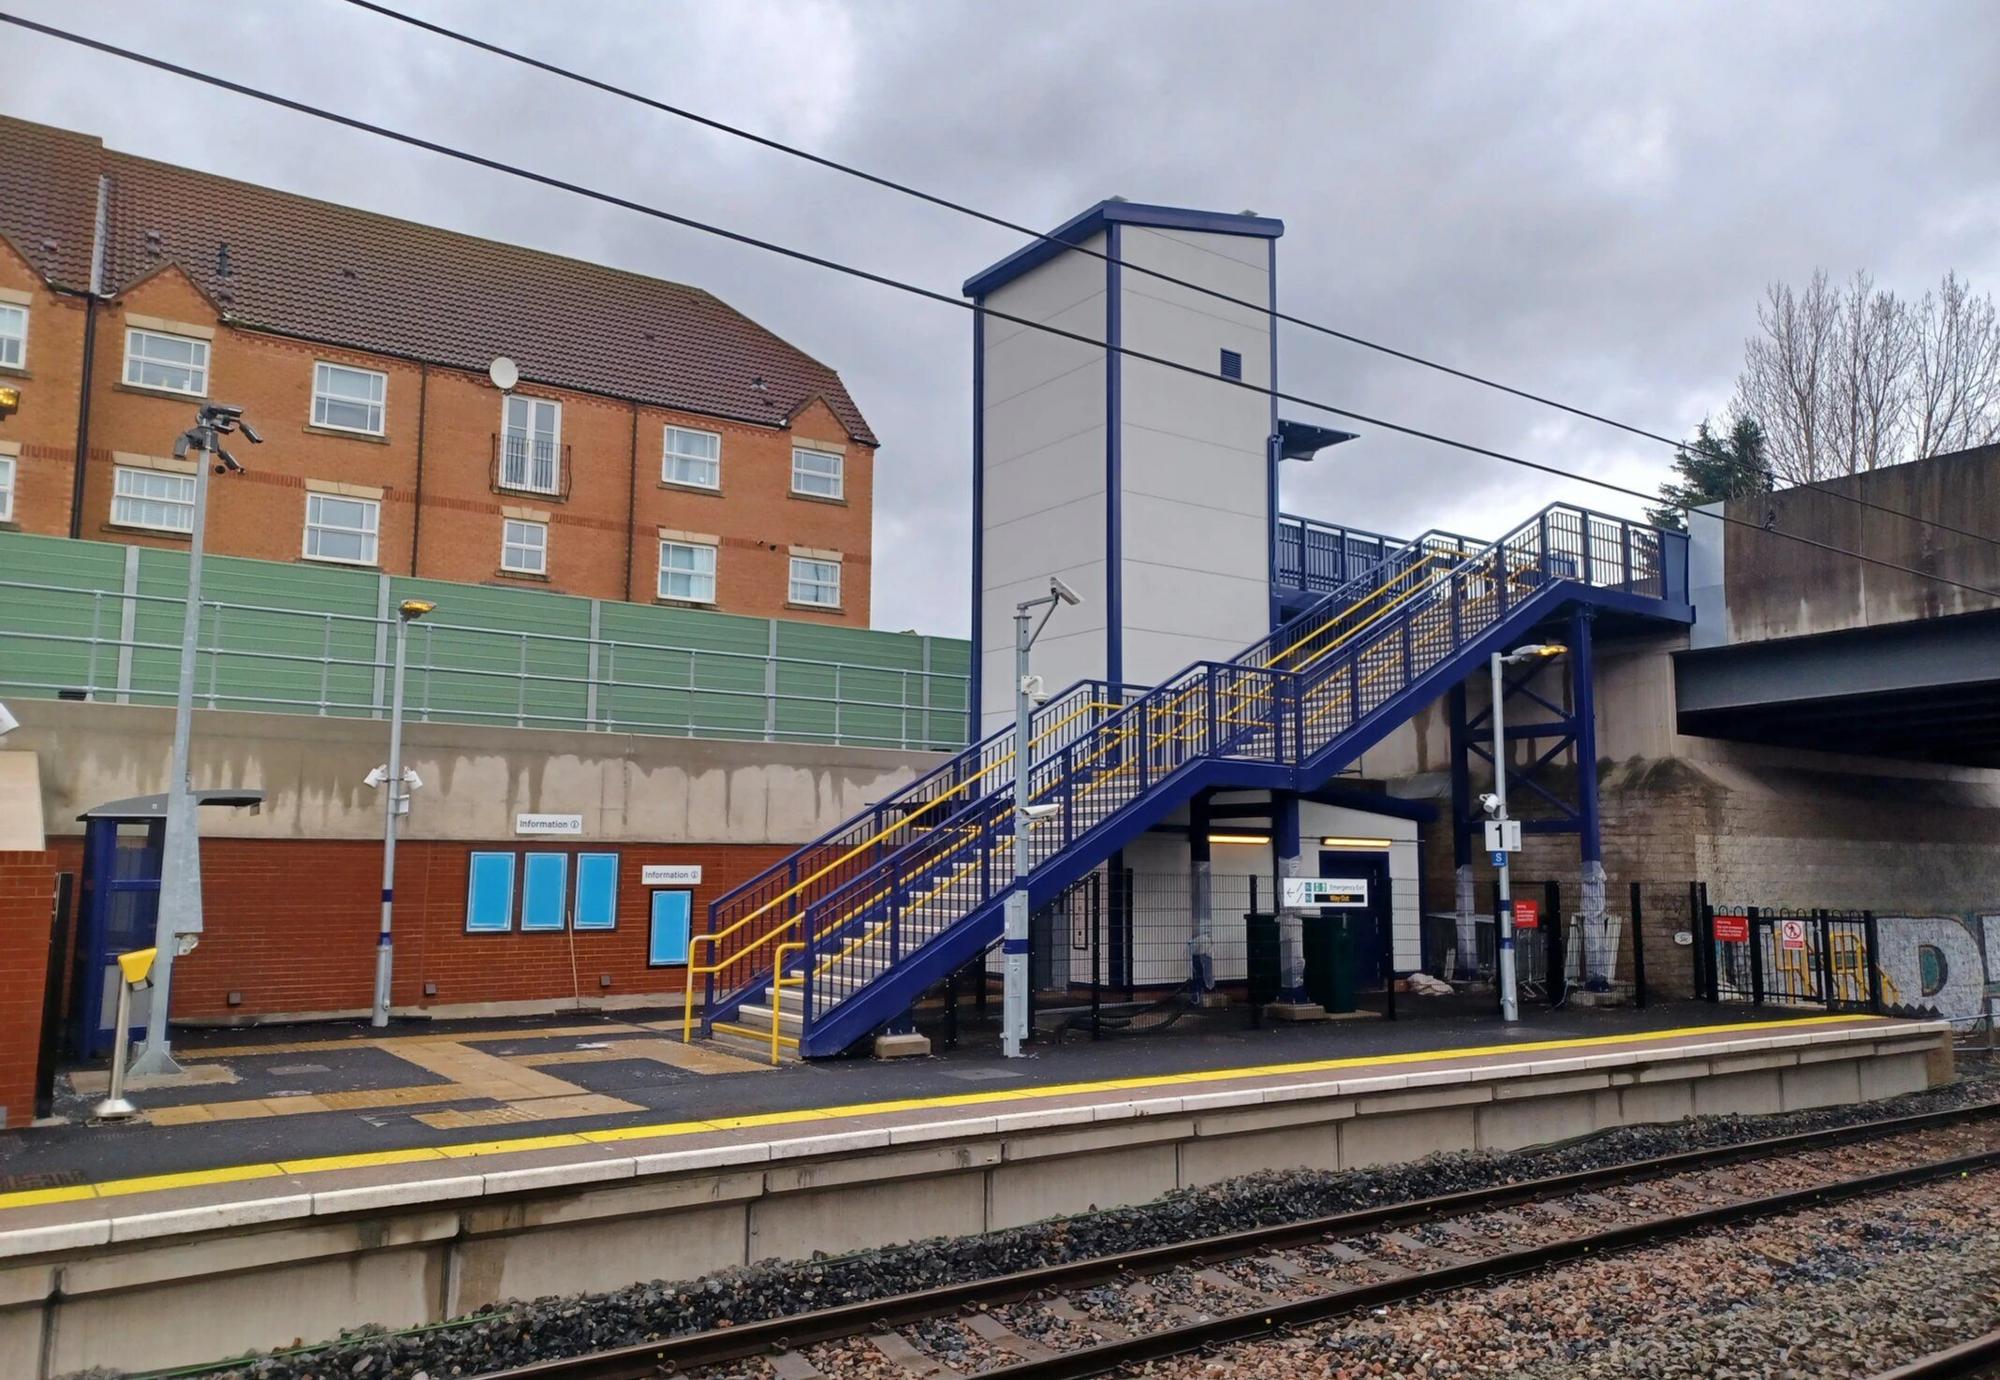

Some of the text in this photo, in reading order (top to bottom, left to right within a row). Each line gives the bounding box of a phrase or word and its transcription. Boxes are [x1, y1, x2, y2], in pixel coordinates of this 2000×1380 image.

[519, 819, 568, 829] Information
[1495, 824, 1503, 848] 1
[1495, 852, 1503, 862] S
[645, 870, 689, 880] Information
